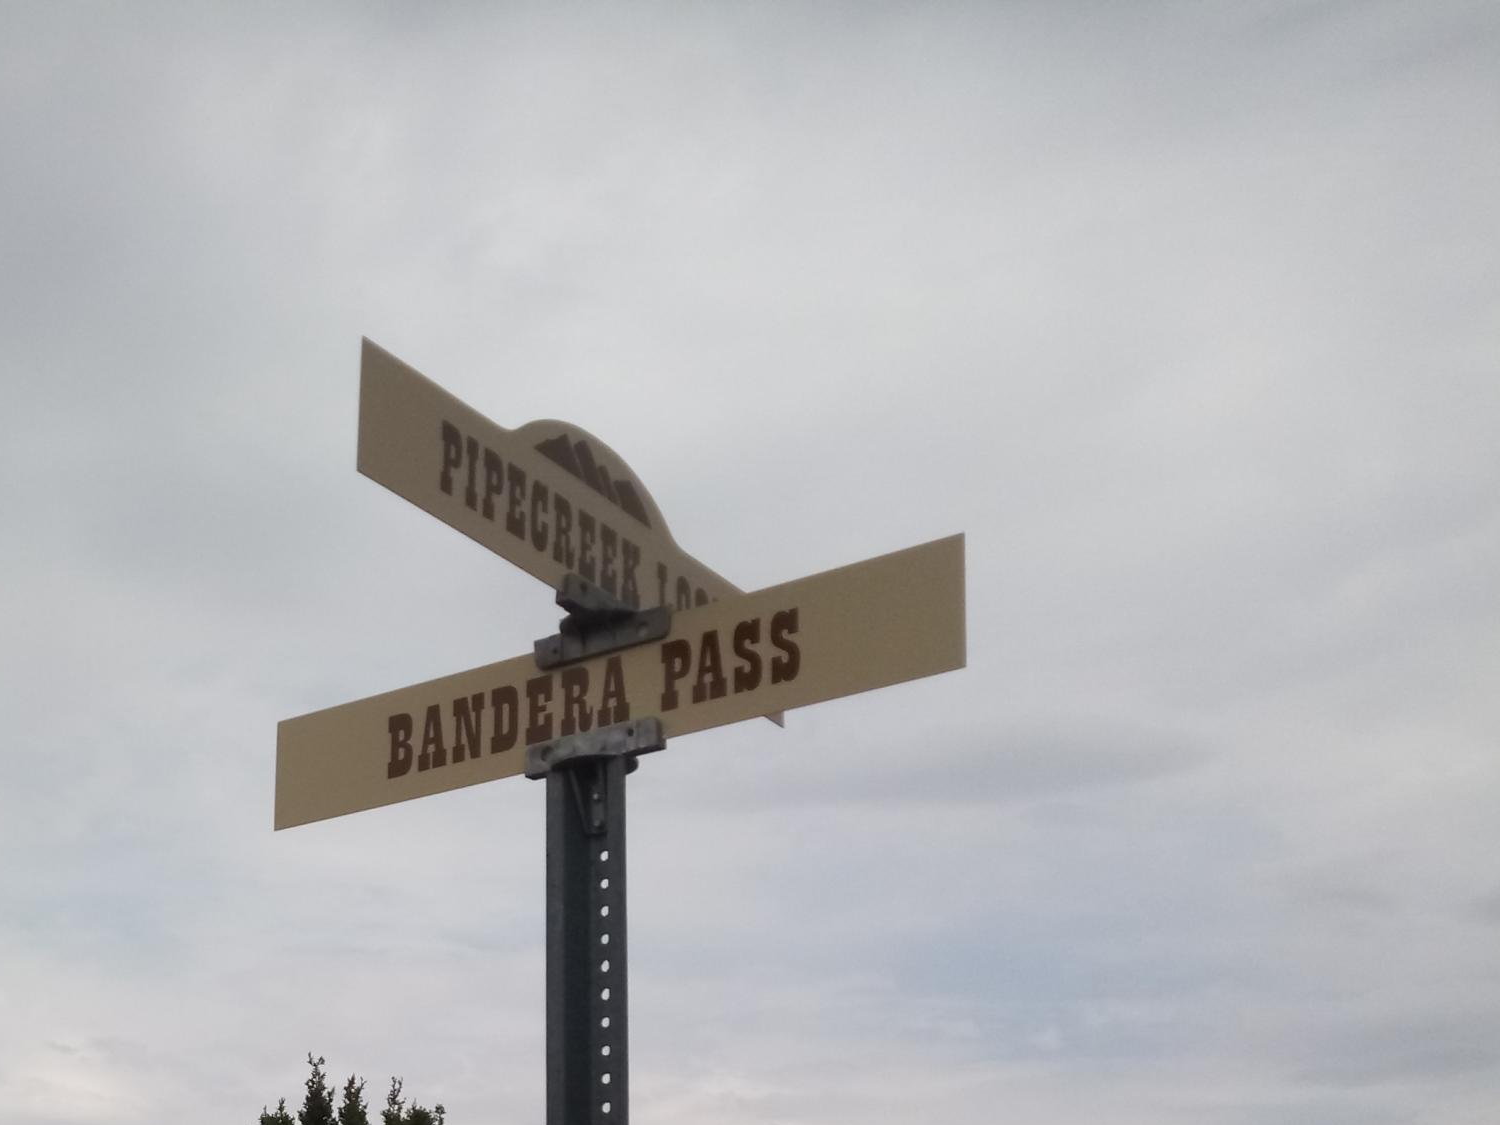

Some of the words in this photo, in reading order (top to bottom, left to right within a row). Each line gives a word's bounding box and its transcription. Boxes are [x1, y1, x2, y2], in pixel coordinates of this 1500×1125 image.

[440, 420, 642, 609] PIPECREEK
[387, 656, 630, 779] BANDERA
[660, 608, 801, 711] PASS
